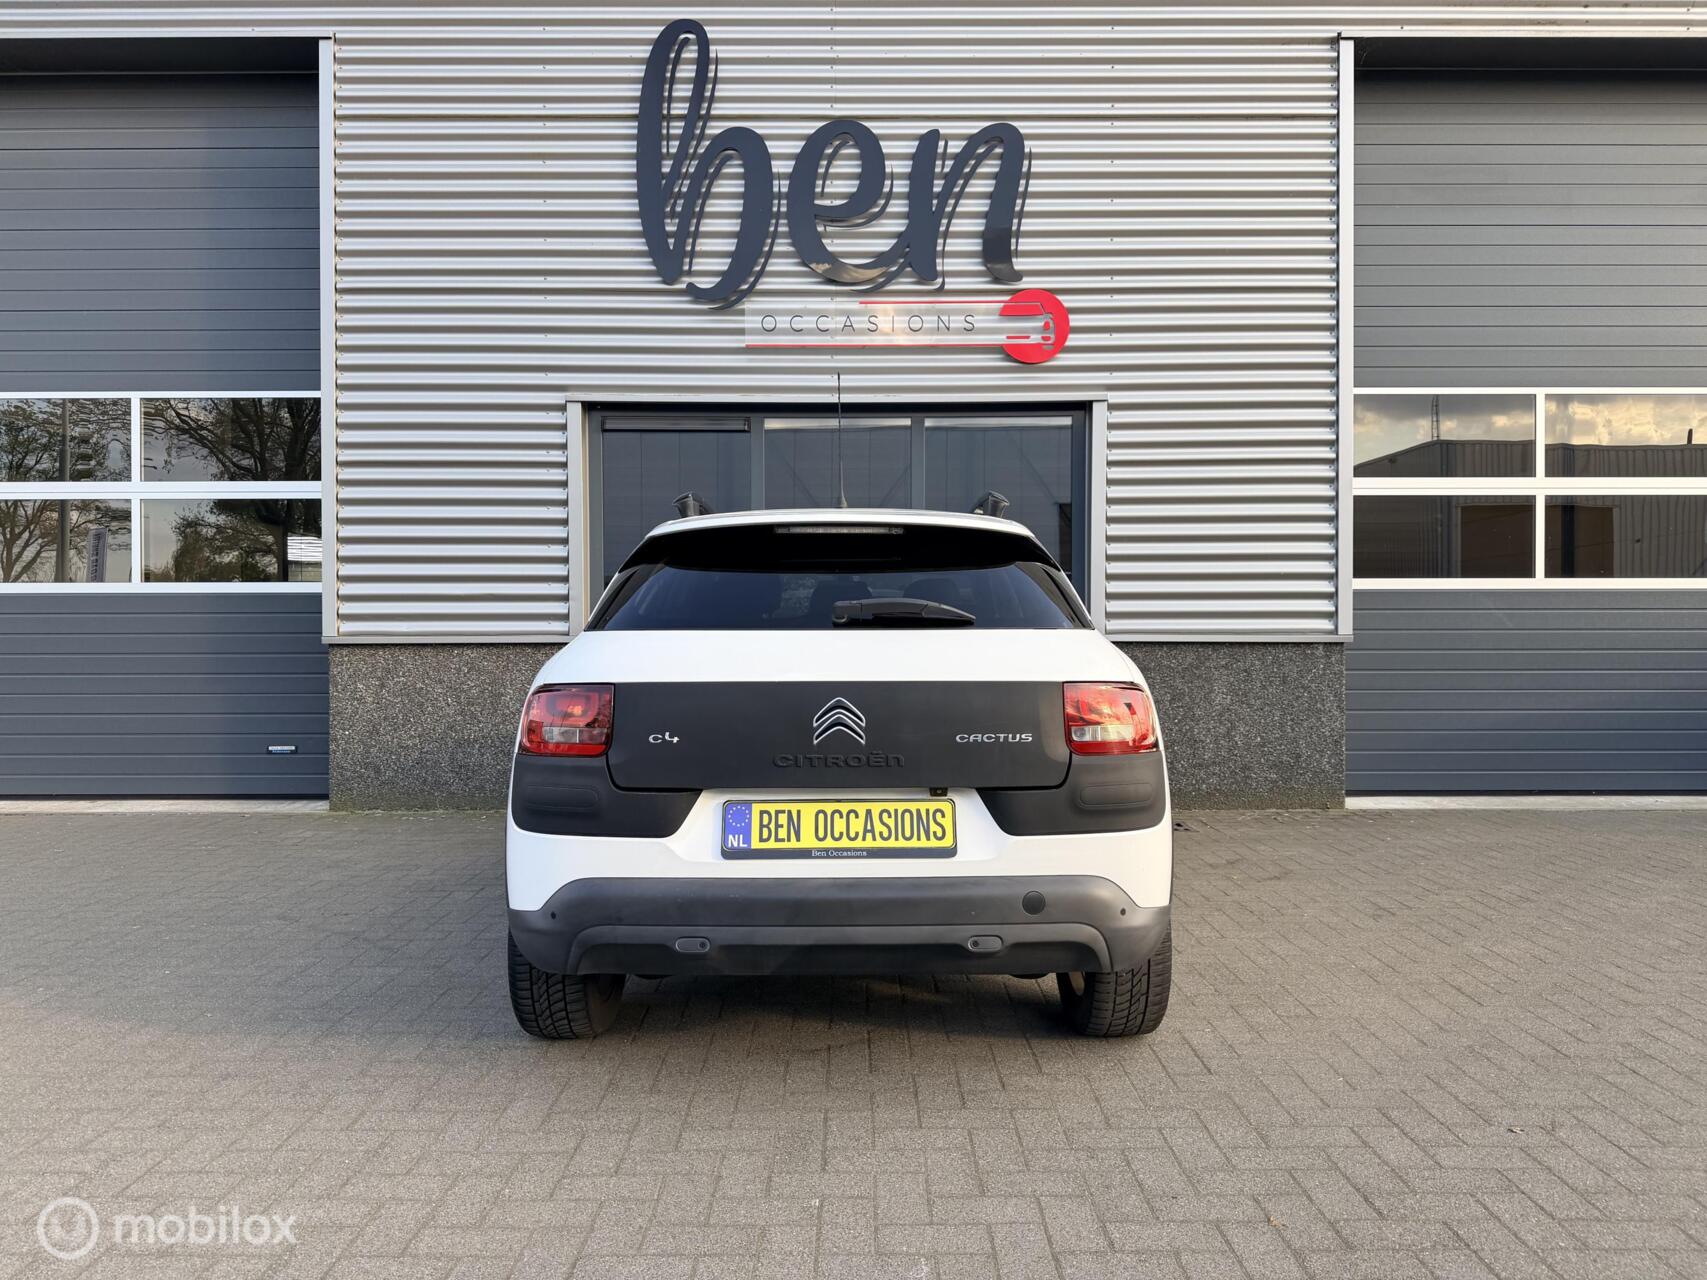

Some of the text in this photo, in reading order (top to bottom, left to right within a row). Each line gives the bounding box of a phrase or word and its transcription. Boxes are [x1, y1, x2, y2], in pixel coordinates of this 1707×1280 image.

[636, 18, 1031, 308] ben
[760, 313, 976, 333] OCCASIONS
[955, 733, 1033, 743] CACTUS
[758, 807, 947, 843] BEN OCCASIONS
[728, 834, 748, 848] NL
[811, 849, 867, 858] Ben Occasions
